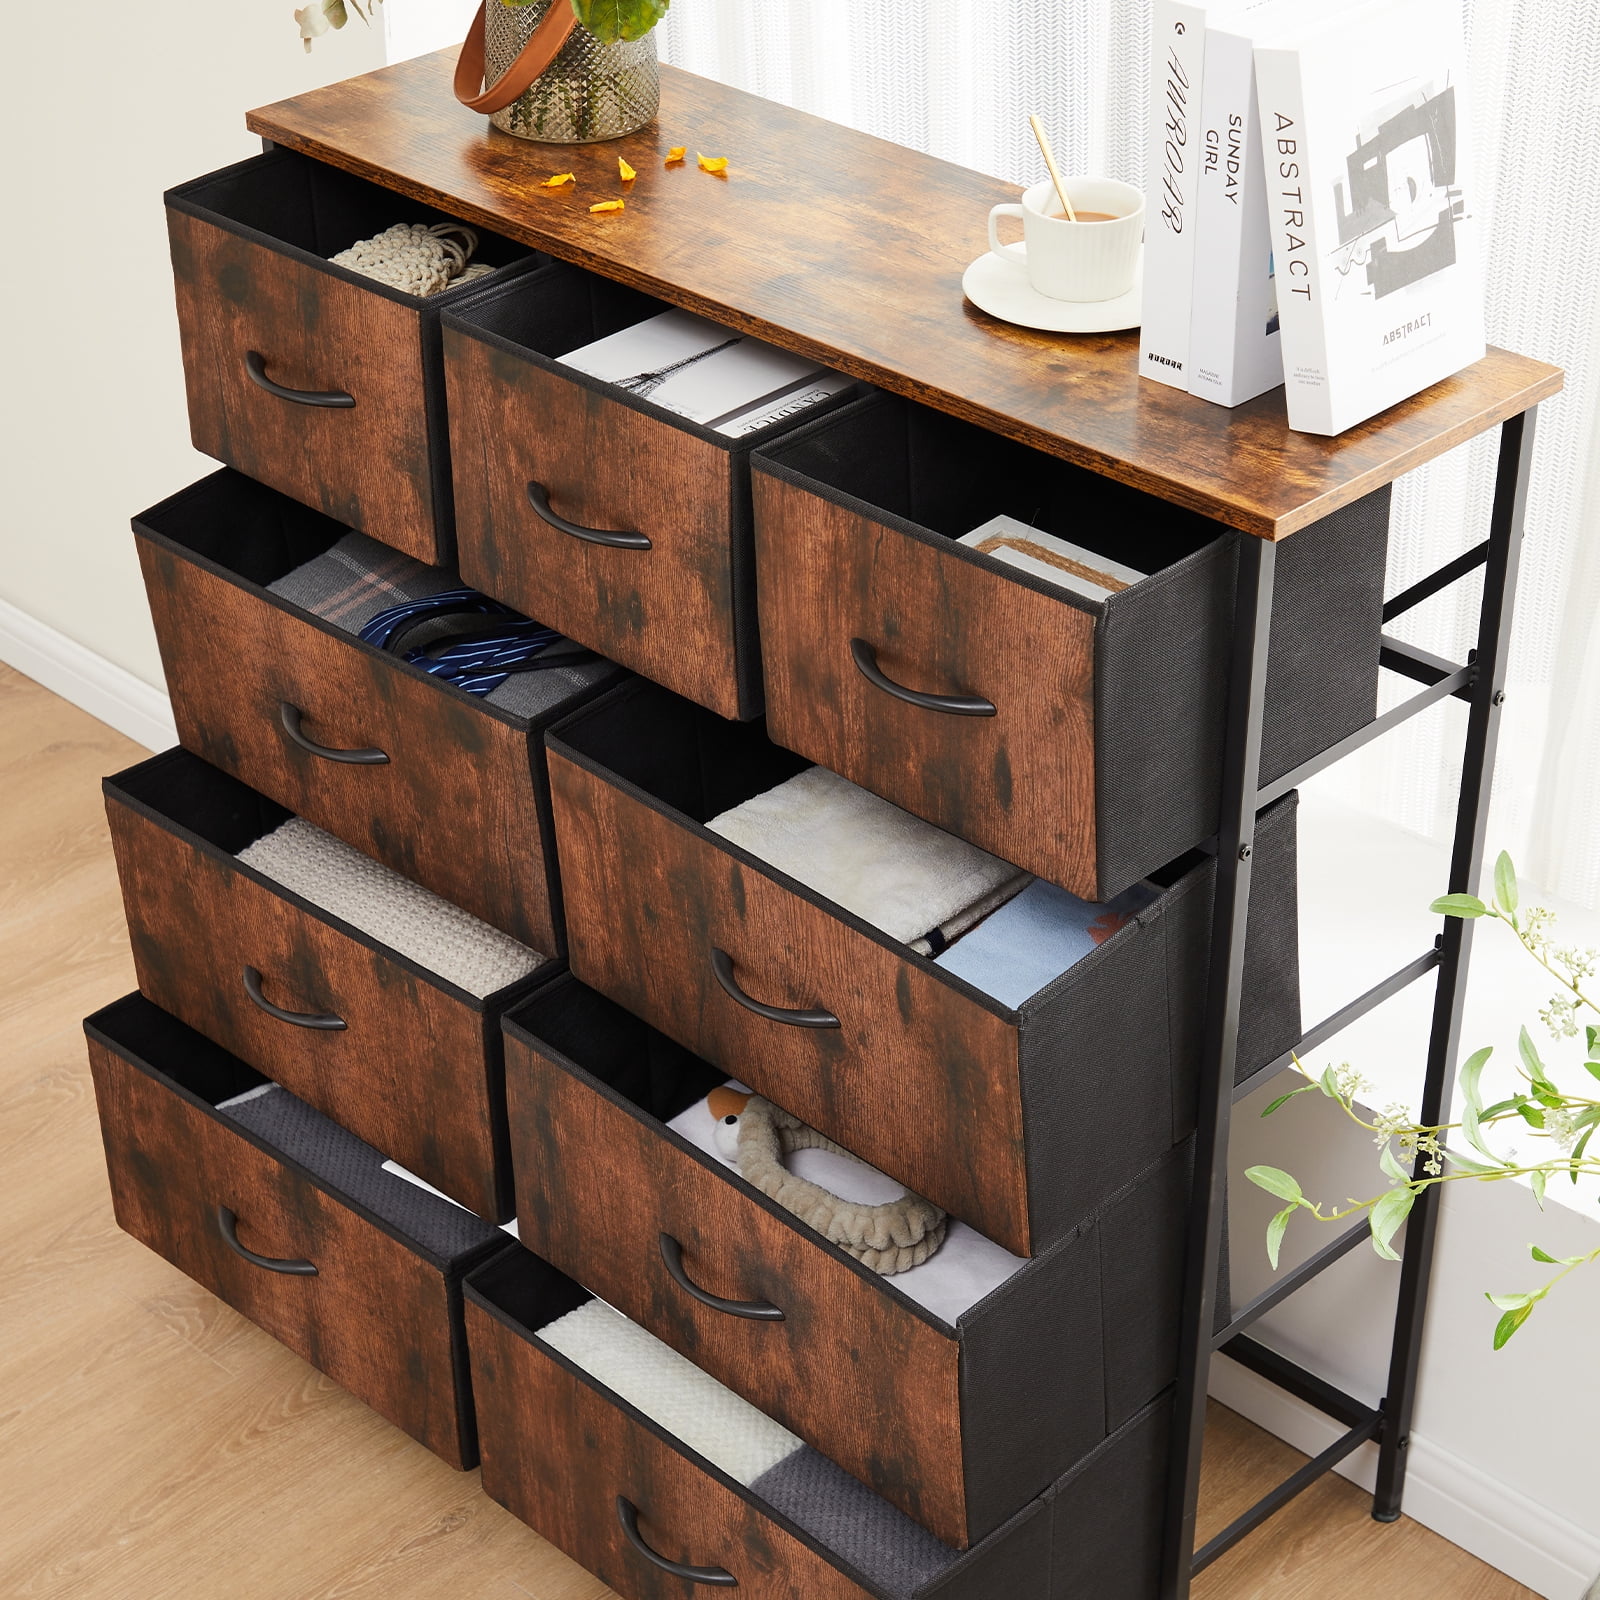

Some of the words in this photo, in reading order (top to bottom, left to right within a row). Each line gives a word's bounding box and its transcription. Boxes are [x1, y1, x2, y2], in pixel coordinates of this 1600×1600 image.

[1204, 129, 1219, 175] GIRL
[1225, 114, 1242, 205] SUNDAY
[1274, 111, 1312, 302] ABSTRACT
[1382, 312, 1431, 346] ABSTRACT
